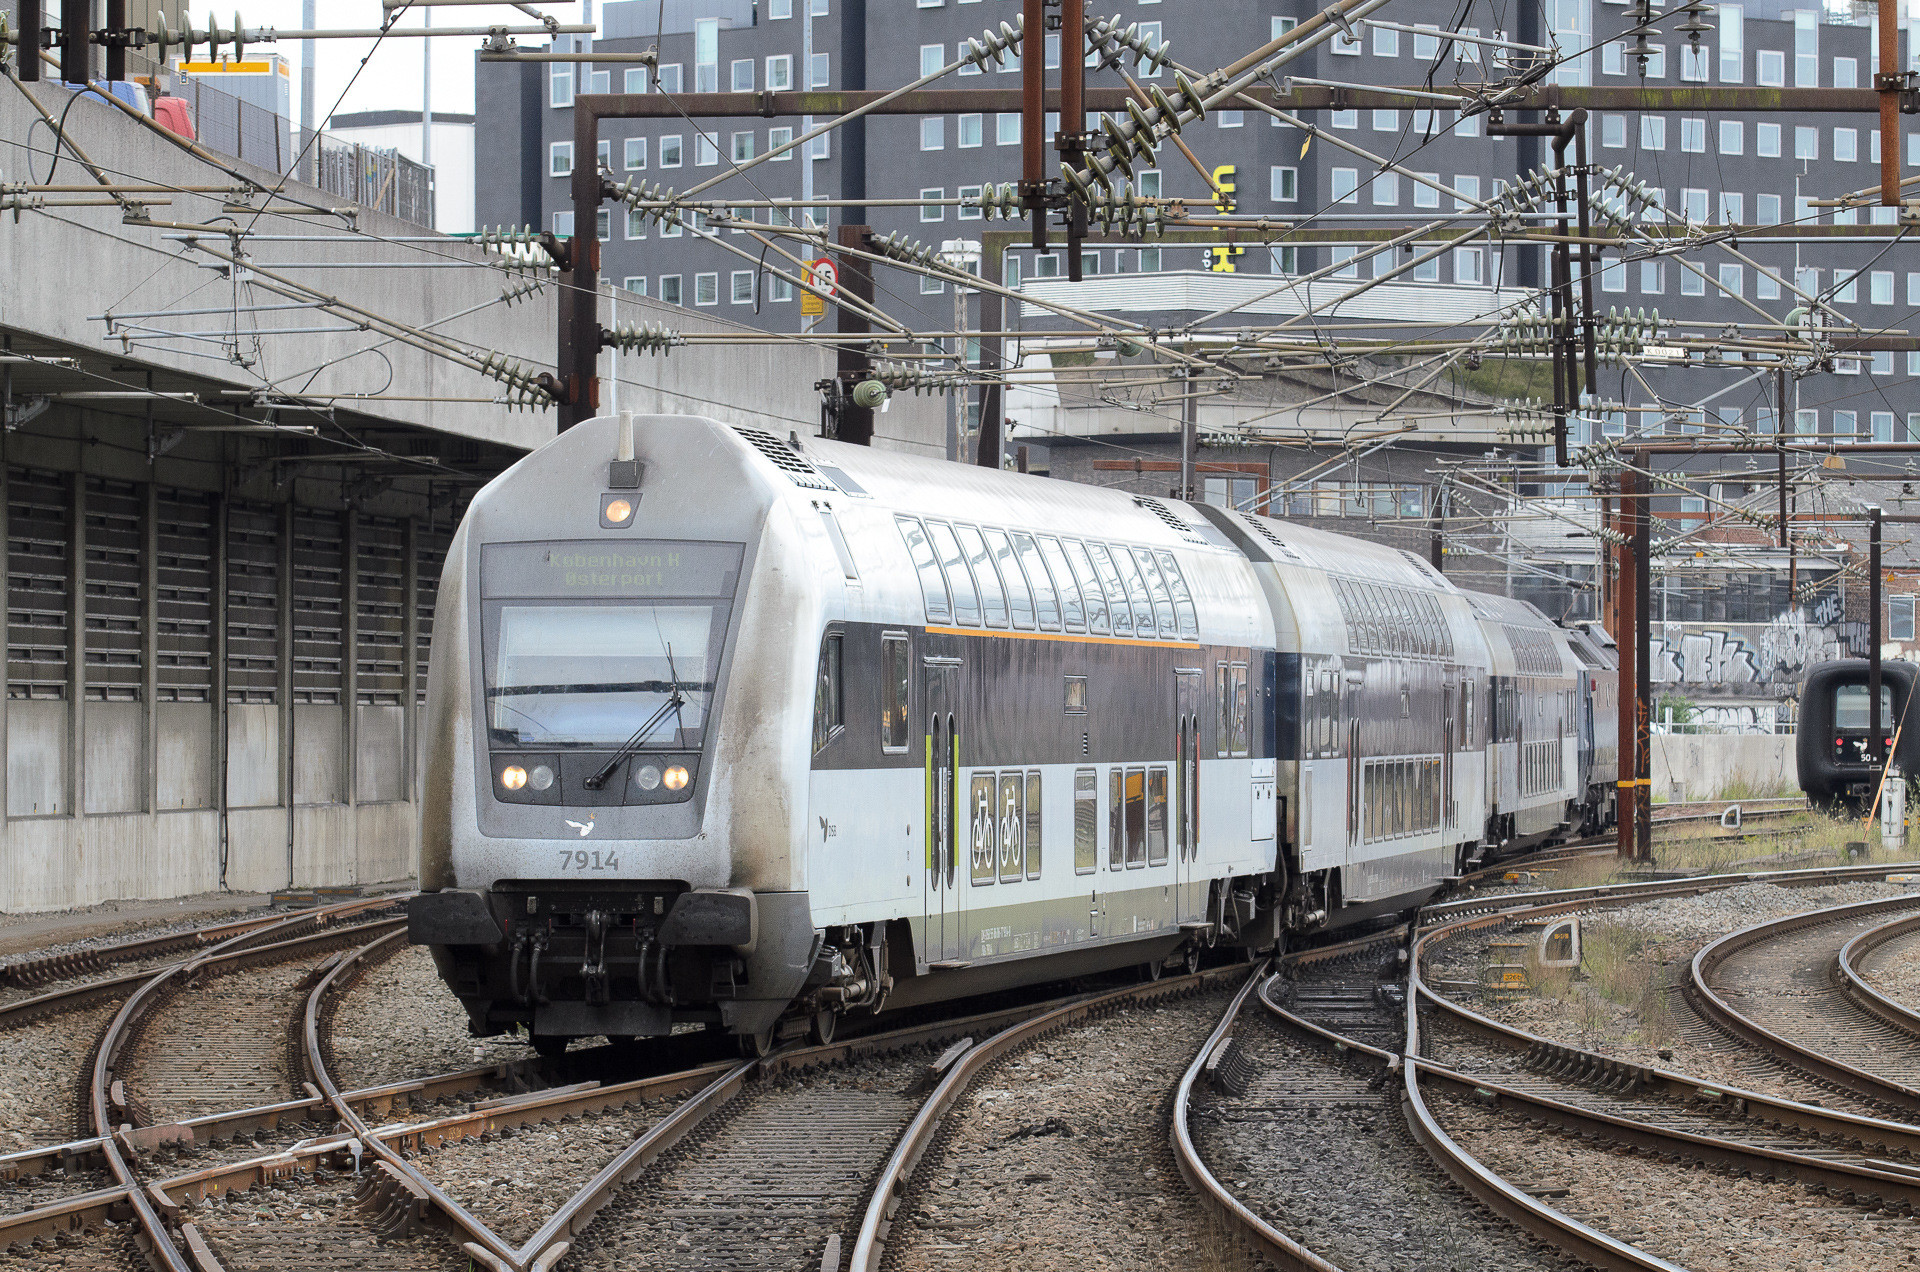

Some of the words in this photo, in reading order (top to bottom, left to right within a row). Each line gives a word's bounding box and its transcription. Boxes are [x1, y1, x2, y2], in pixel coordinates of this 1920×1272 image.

[818, 270, 832, 285] 15
[549, 553, 662, 567] København
[668, 553, 681, 567] H
[565, 571, 663, 586] Østerport
[829, 824, 837, 837] DSB
[559, 850, 619, 871] 7914
